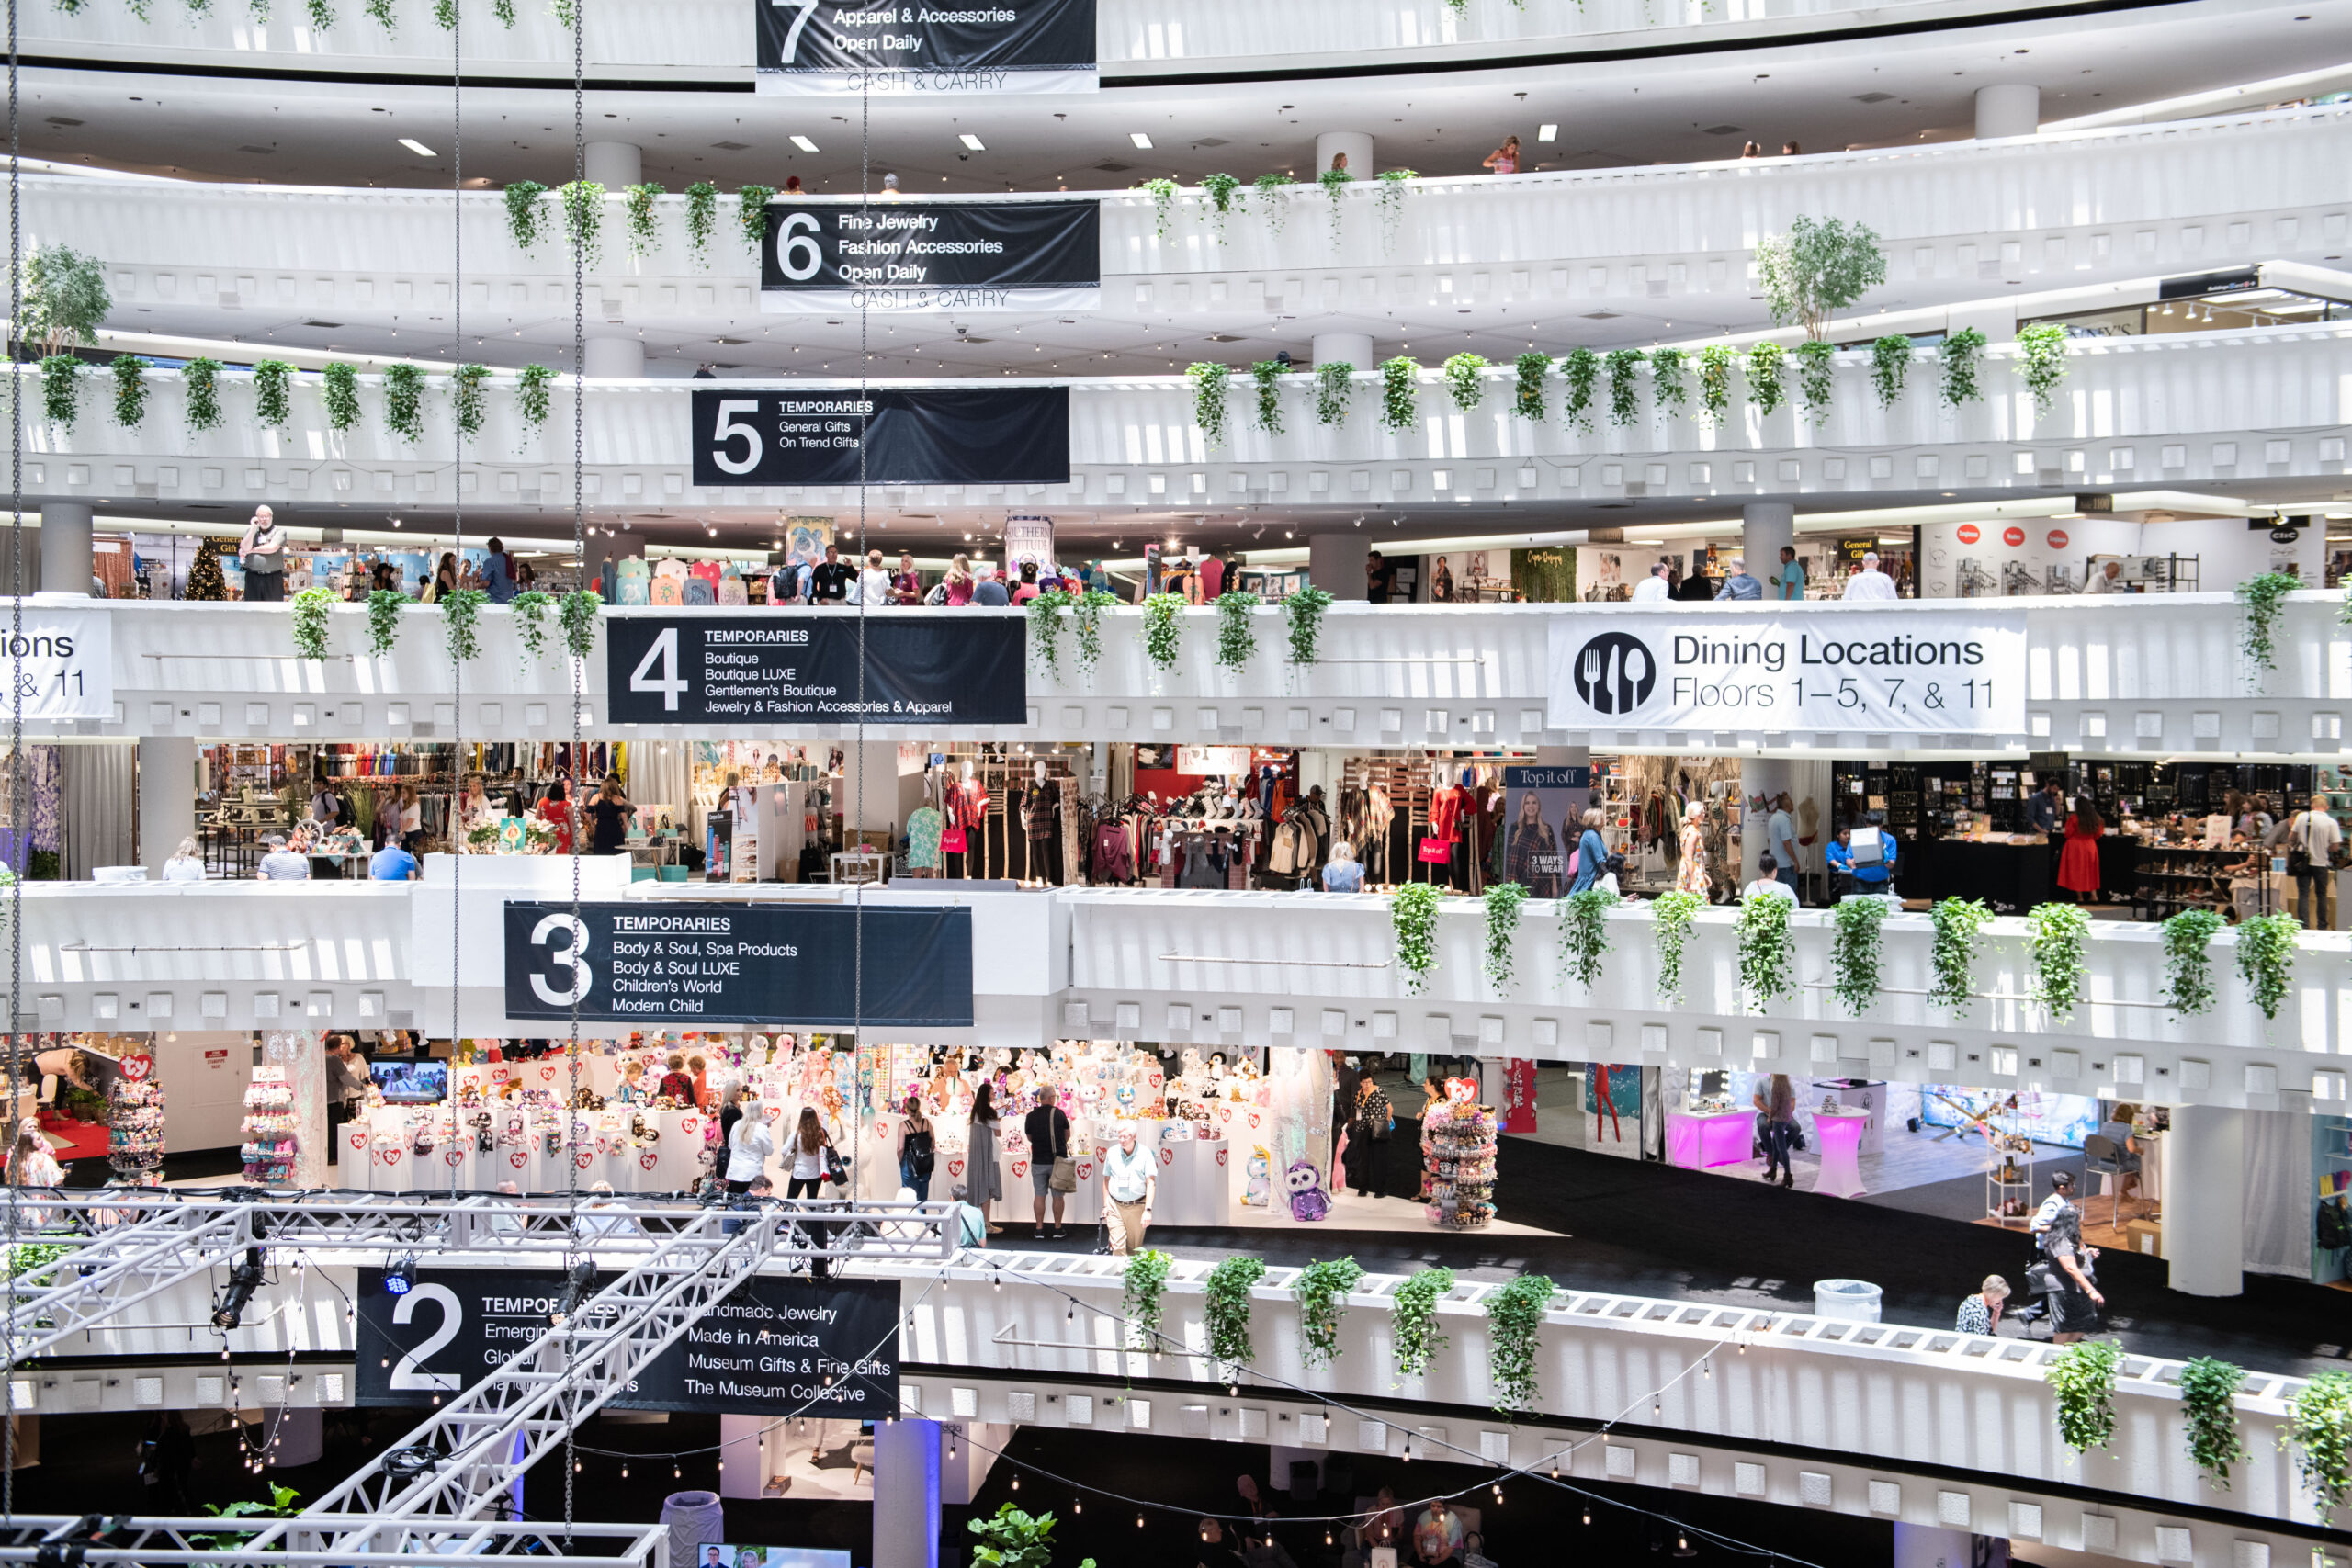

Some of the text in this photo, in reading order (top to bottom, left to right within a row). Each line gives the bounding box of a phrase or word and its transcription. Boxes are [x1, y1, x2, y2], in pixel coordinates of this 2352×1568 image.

[833, 7, 1016, 26] Apparel & Accessories
[772, 0, 819, 64] 7
[833, 35, 922, 52] Open Daily
[847, 72, 1008, 91] CASH & CARRY
[838, 214, 939, 232] Fine Jewelry
[777, 213, 822, 281] 6
[838, 239, 1003, 254] Fashion Accessories
[838, 265, 927, 282] Open Daily
[851, 289, 1010, 308] CASH & CARRY
[779, 401, 874, 412] TEMPORARIES
[779, 422, 851, 433] General Gifts
[712, 400, 763, 474] 5
[779, 437, 860, 448] On Trend Gifts
[220, 544, 237, 552] Gift
[1008, 539, 1048, 551] TTITUDE
[1844, 540, 1872, 549] General
[705, 630, 809, 643] TEMPORARIES
[706, 653, 759, 667] Boutique
[1674, 634, 1984, 672] Dining Locations
[629, 628, 689, 711] 4
[706, 669, 796, 682] Boutique LUXE
[20, 669, 84, 697] & 11
[705, 684, 837, 698] Gentlemen's Boutique
[1673, 677, 1774, 707] Floors
[1883, 678, 1908, 713] 7,
[1924, 682, 1946, 709] &
[1962, 678, 1993, 709] 11
[705, 701, 952, 716] Jewelry & Fashion Accessories & Apparel
[1521, 769, 1574, 787] Top it off
[1423, 846, 1431, 854] Top
[1532, 855, 1564, 865] 3 WAYS
[1532, 865, 1563, 874] TO WEAR
[613, 917, 731, 931] TEMPORARIES
[613, 942, 798, 957] Body & Soul, Spa Products
[529, 913, 593, 1007] 3
[613, 961, 740, 976] Body & Soul LUXE
[613, 979, 722, 994] Children's World
[612, 998, 704, 1013] Modern Child
[120, 1055, 150, 1078] ty
[1149, 1075, 1161, 1087] ty
[1446, 1078, 1476, 1103] ty
[683, 1119, 697, 1133] ty
[877, 1123, 888, 1137] ty
[351, 1134, 368, 1148] ty
[384, 1150, 401, 1165] ty
[510, 1153, 526, 1168] ty
[576, 1153, 592, 1168] ty
[640, 1155, 657, 1168] ty
[1161, 1149, 1172, 1164] ty
[1217, 1150, 1227, 1165] ty
[949, 1161, 964, 1176] ty
[1012, 1161, 1027, 1176] ty
[1077, 1164, 1092, 1179] ty
[778, 1304, 838, 1325] Jewelry
[390, 1282, 463, 1391] 2
[485, 1323, 550, 1342] Emergin
[689, 1328, 820, 1348] Made in America
[689, 1353, 891, 1376] Museum Gifts & Fine Gifts
[684, 1379, 865, 1402] The Museum Collective
